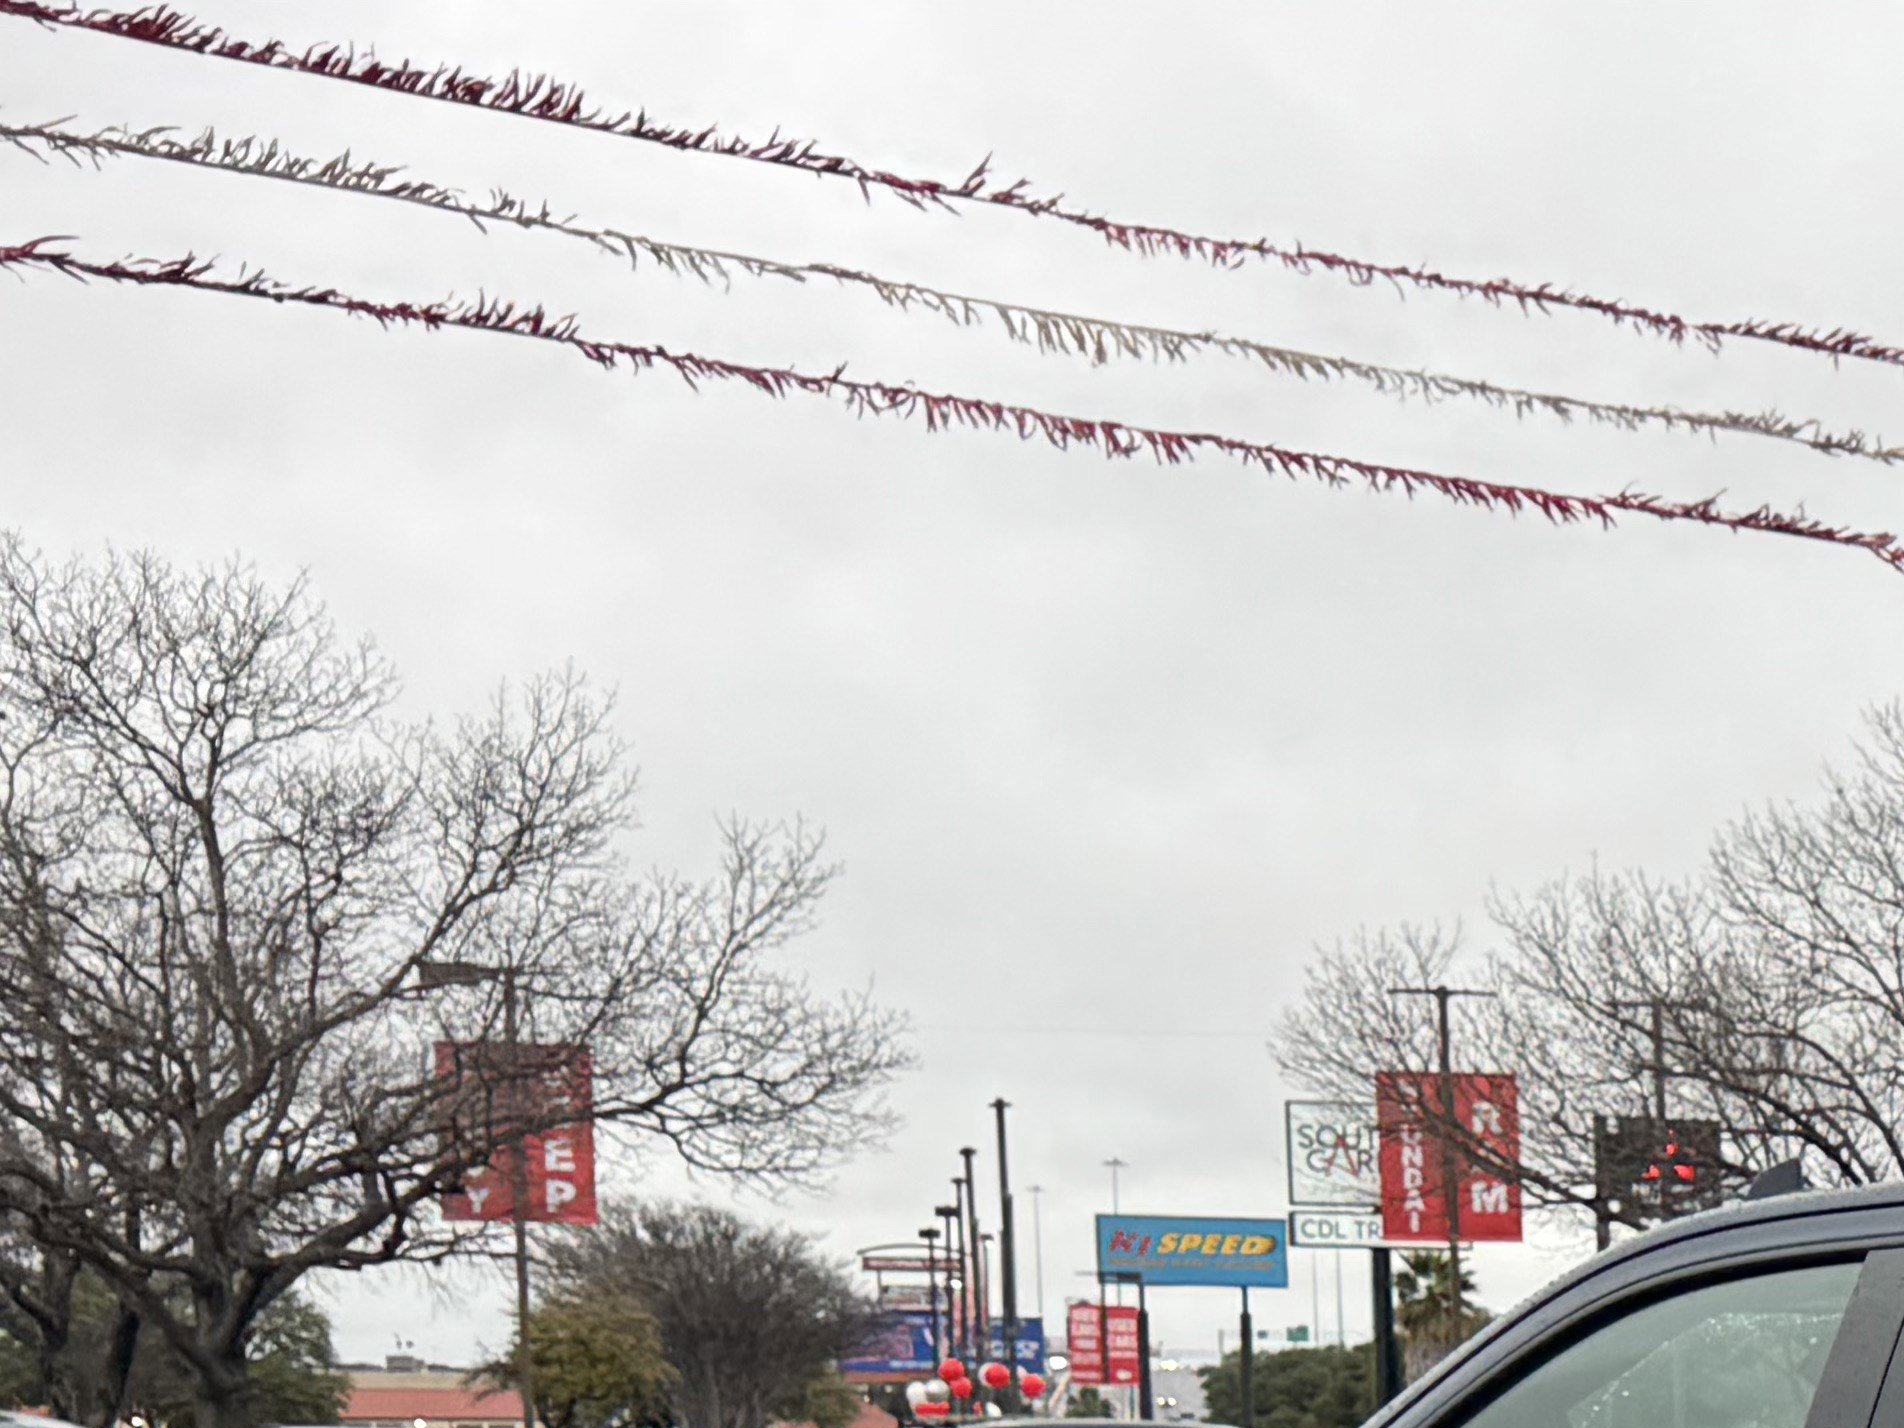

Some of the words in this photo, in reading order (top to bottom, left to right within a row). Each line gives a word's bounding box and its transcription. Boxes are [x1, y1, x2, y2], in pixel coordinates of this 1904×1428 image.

[1470, 1101, 1509, 1213] RM
[1301, 1219, 1347, 1239] CDL
[1157, 1232, 1277, 1257] SPEED
